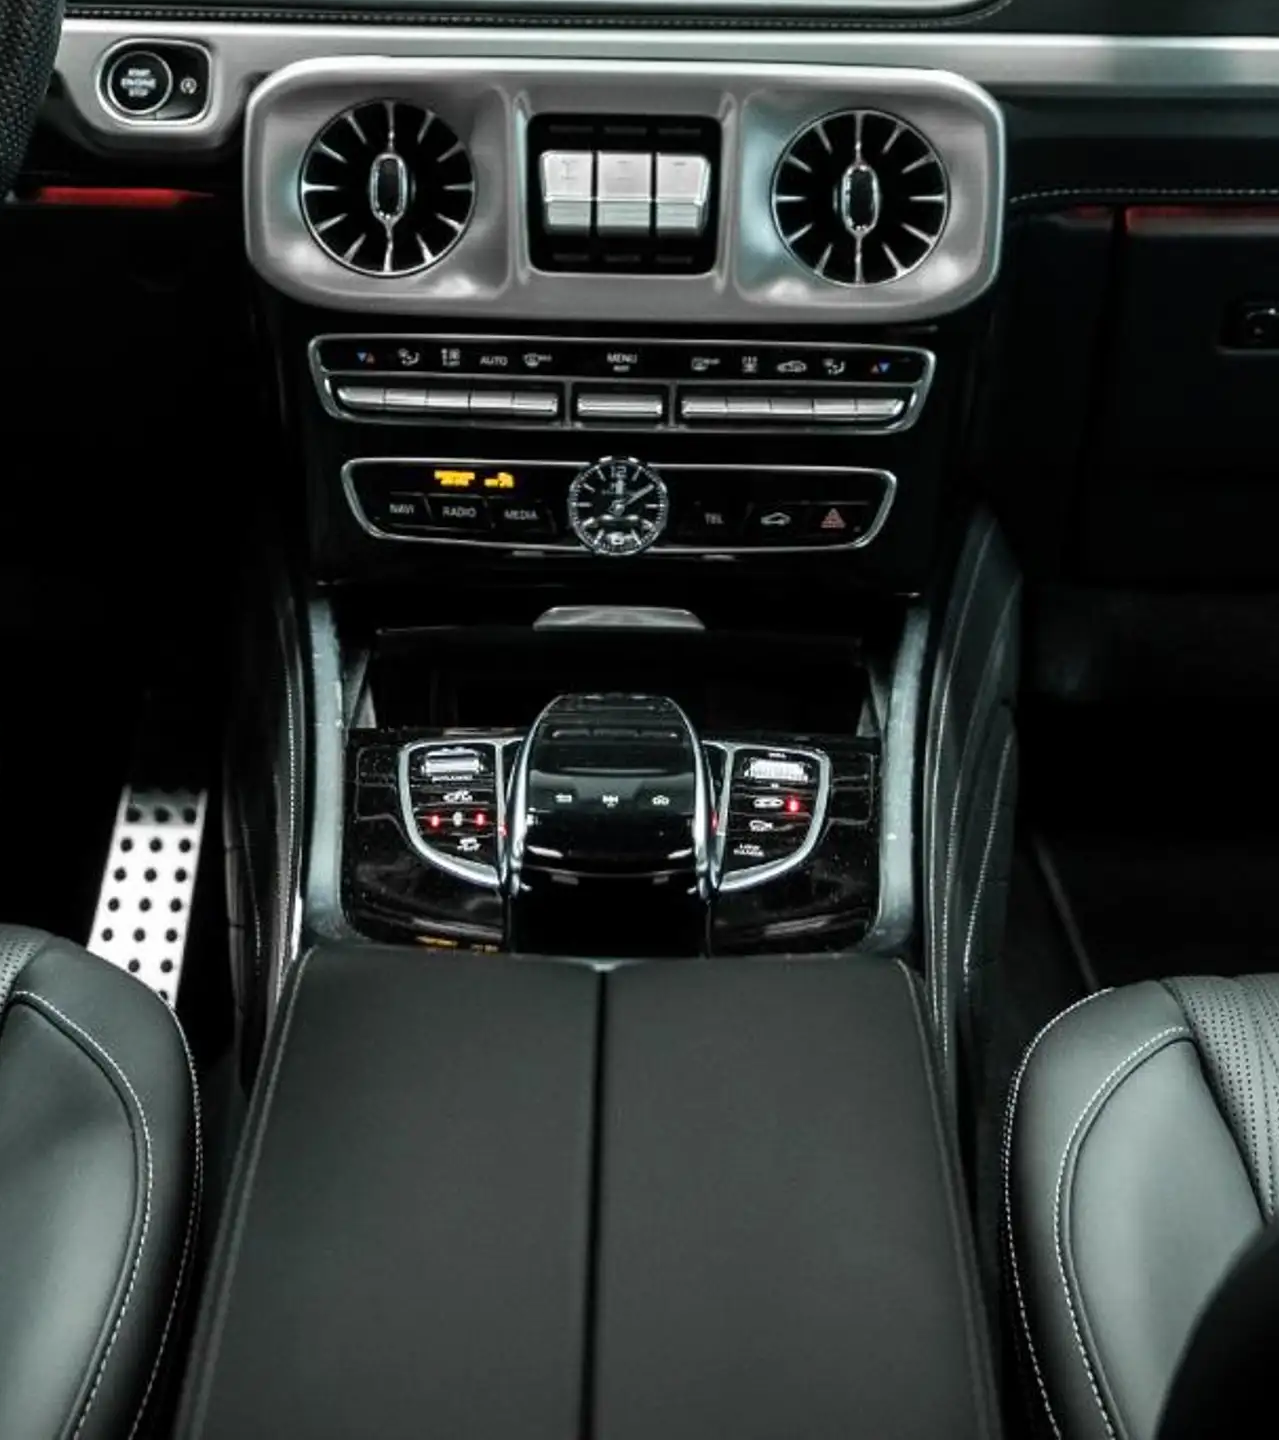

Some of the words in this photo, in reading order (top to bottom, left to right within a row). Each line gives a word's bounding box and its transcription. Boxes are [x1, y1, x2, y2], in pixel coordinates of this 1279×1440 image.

[478, 355, 509, 367] AUTO
[606, 351, 638, 364] MENU
[610, 466, 627, 478] 12
[389, 502, 416, 515] NAVI
[441, 505, 478, 519] RADIO
[503, 508, 540, 521] MEDIA
